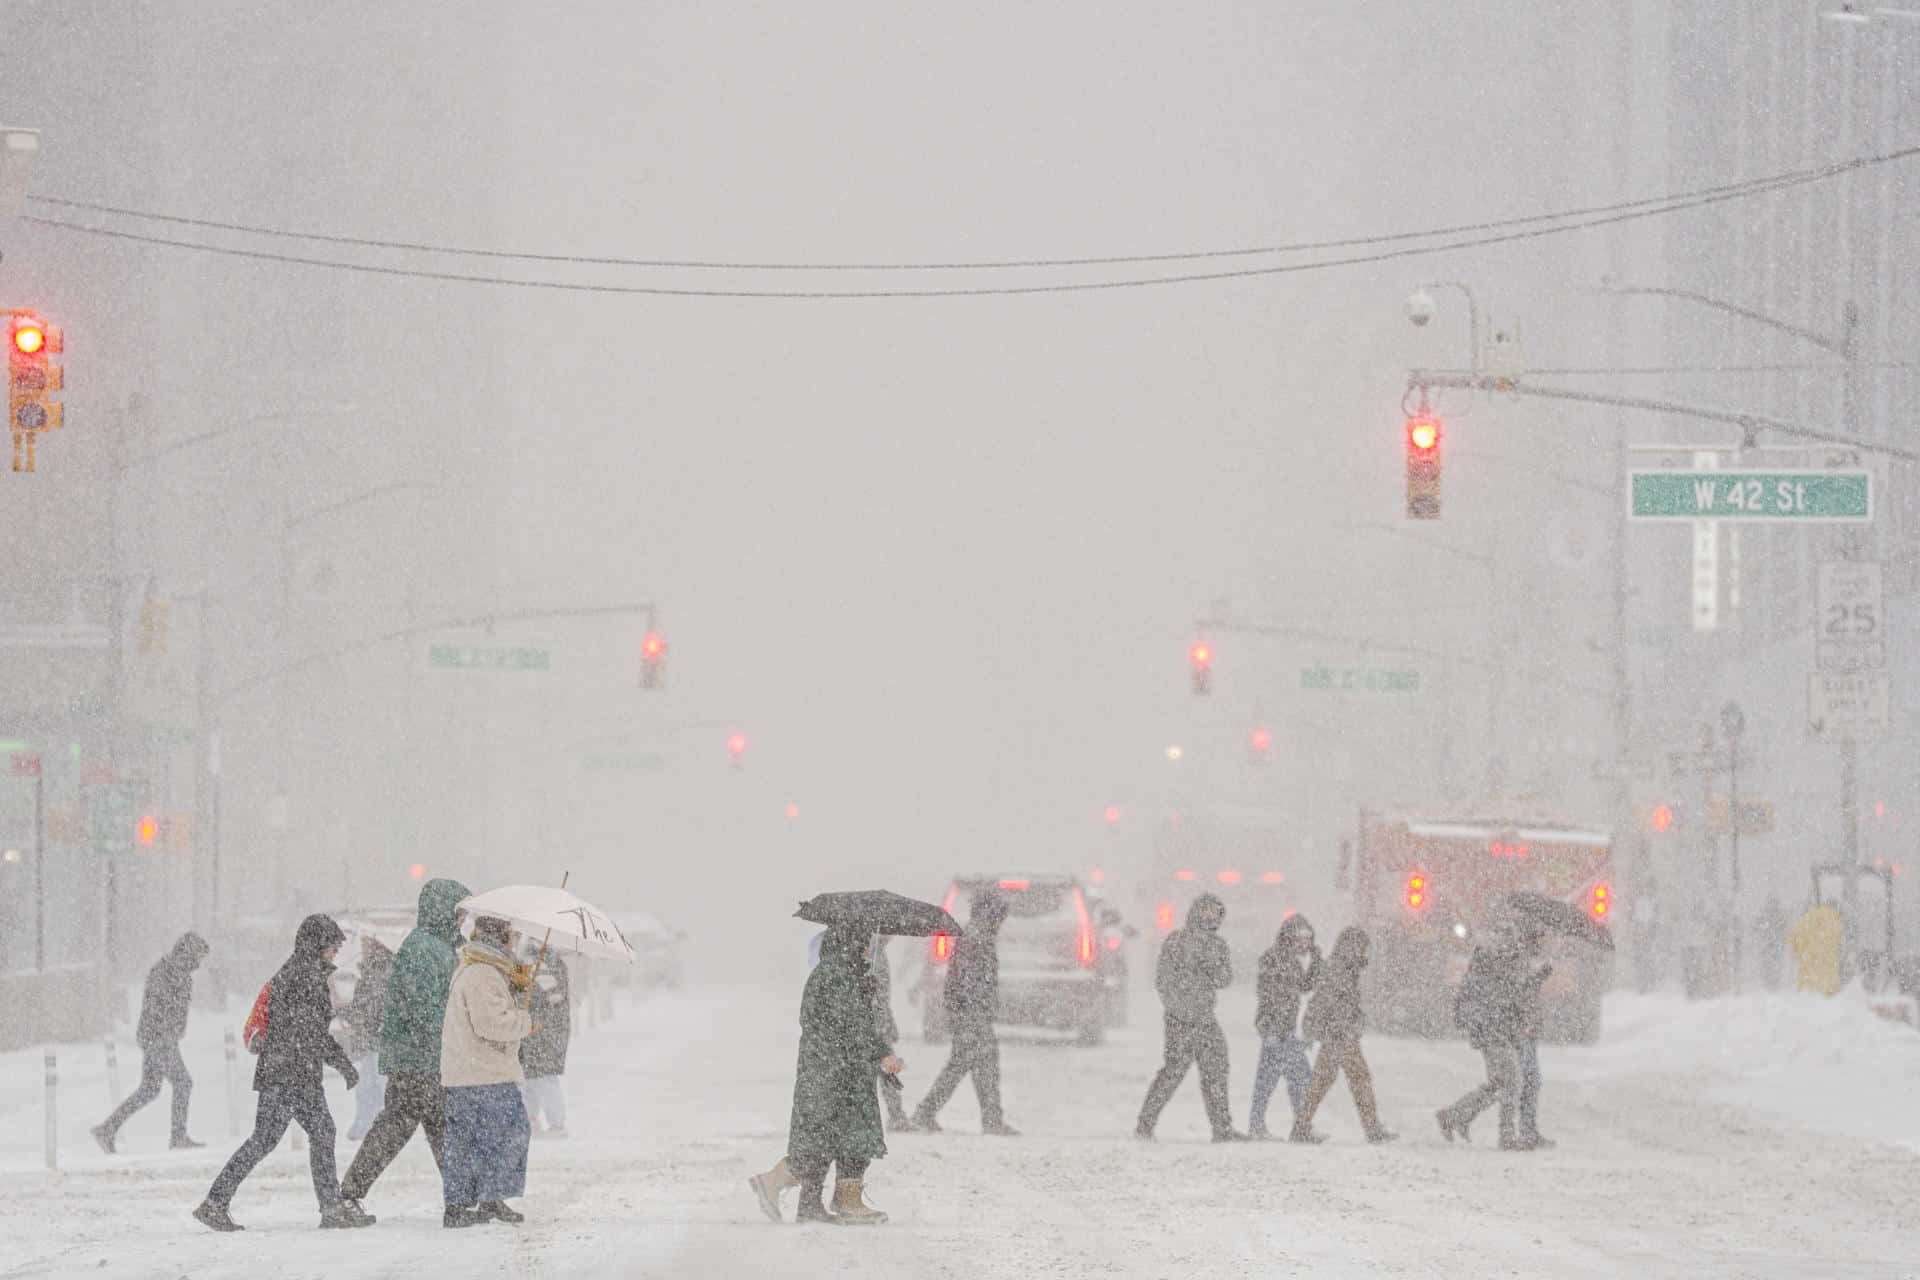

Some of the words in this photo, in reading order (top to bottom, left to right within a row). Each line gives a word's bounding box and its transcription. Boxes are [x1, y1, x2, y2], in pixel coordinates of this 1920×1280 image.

[1694, 480, 1716, 510] W
[1726, 480, 1764, 510] 42
[1777, 481, 1806, 511] St
[1825, 604, 1876, 633] 25
[556, 906, 614, 945] The
